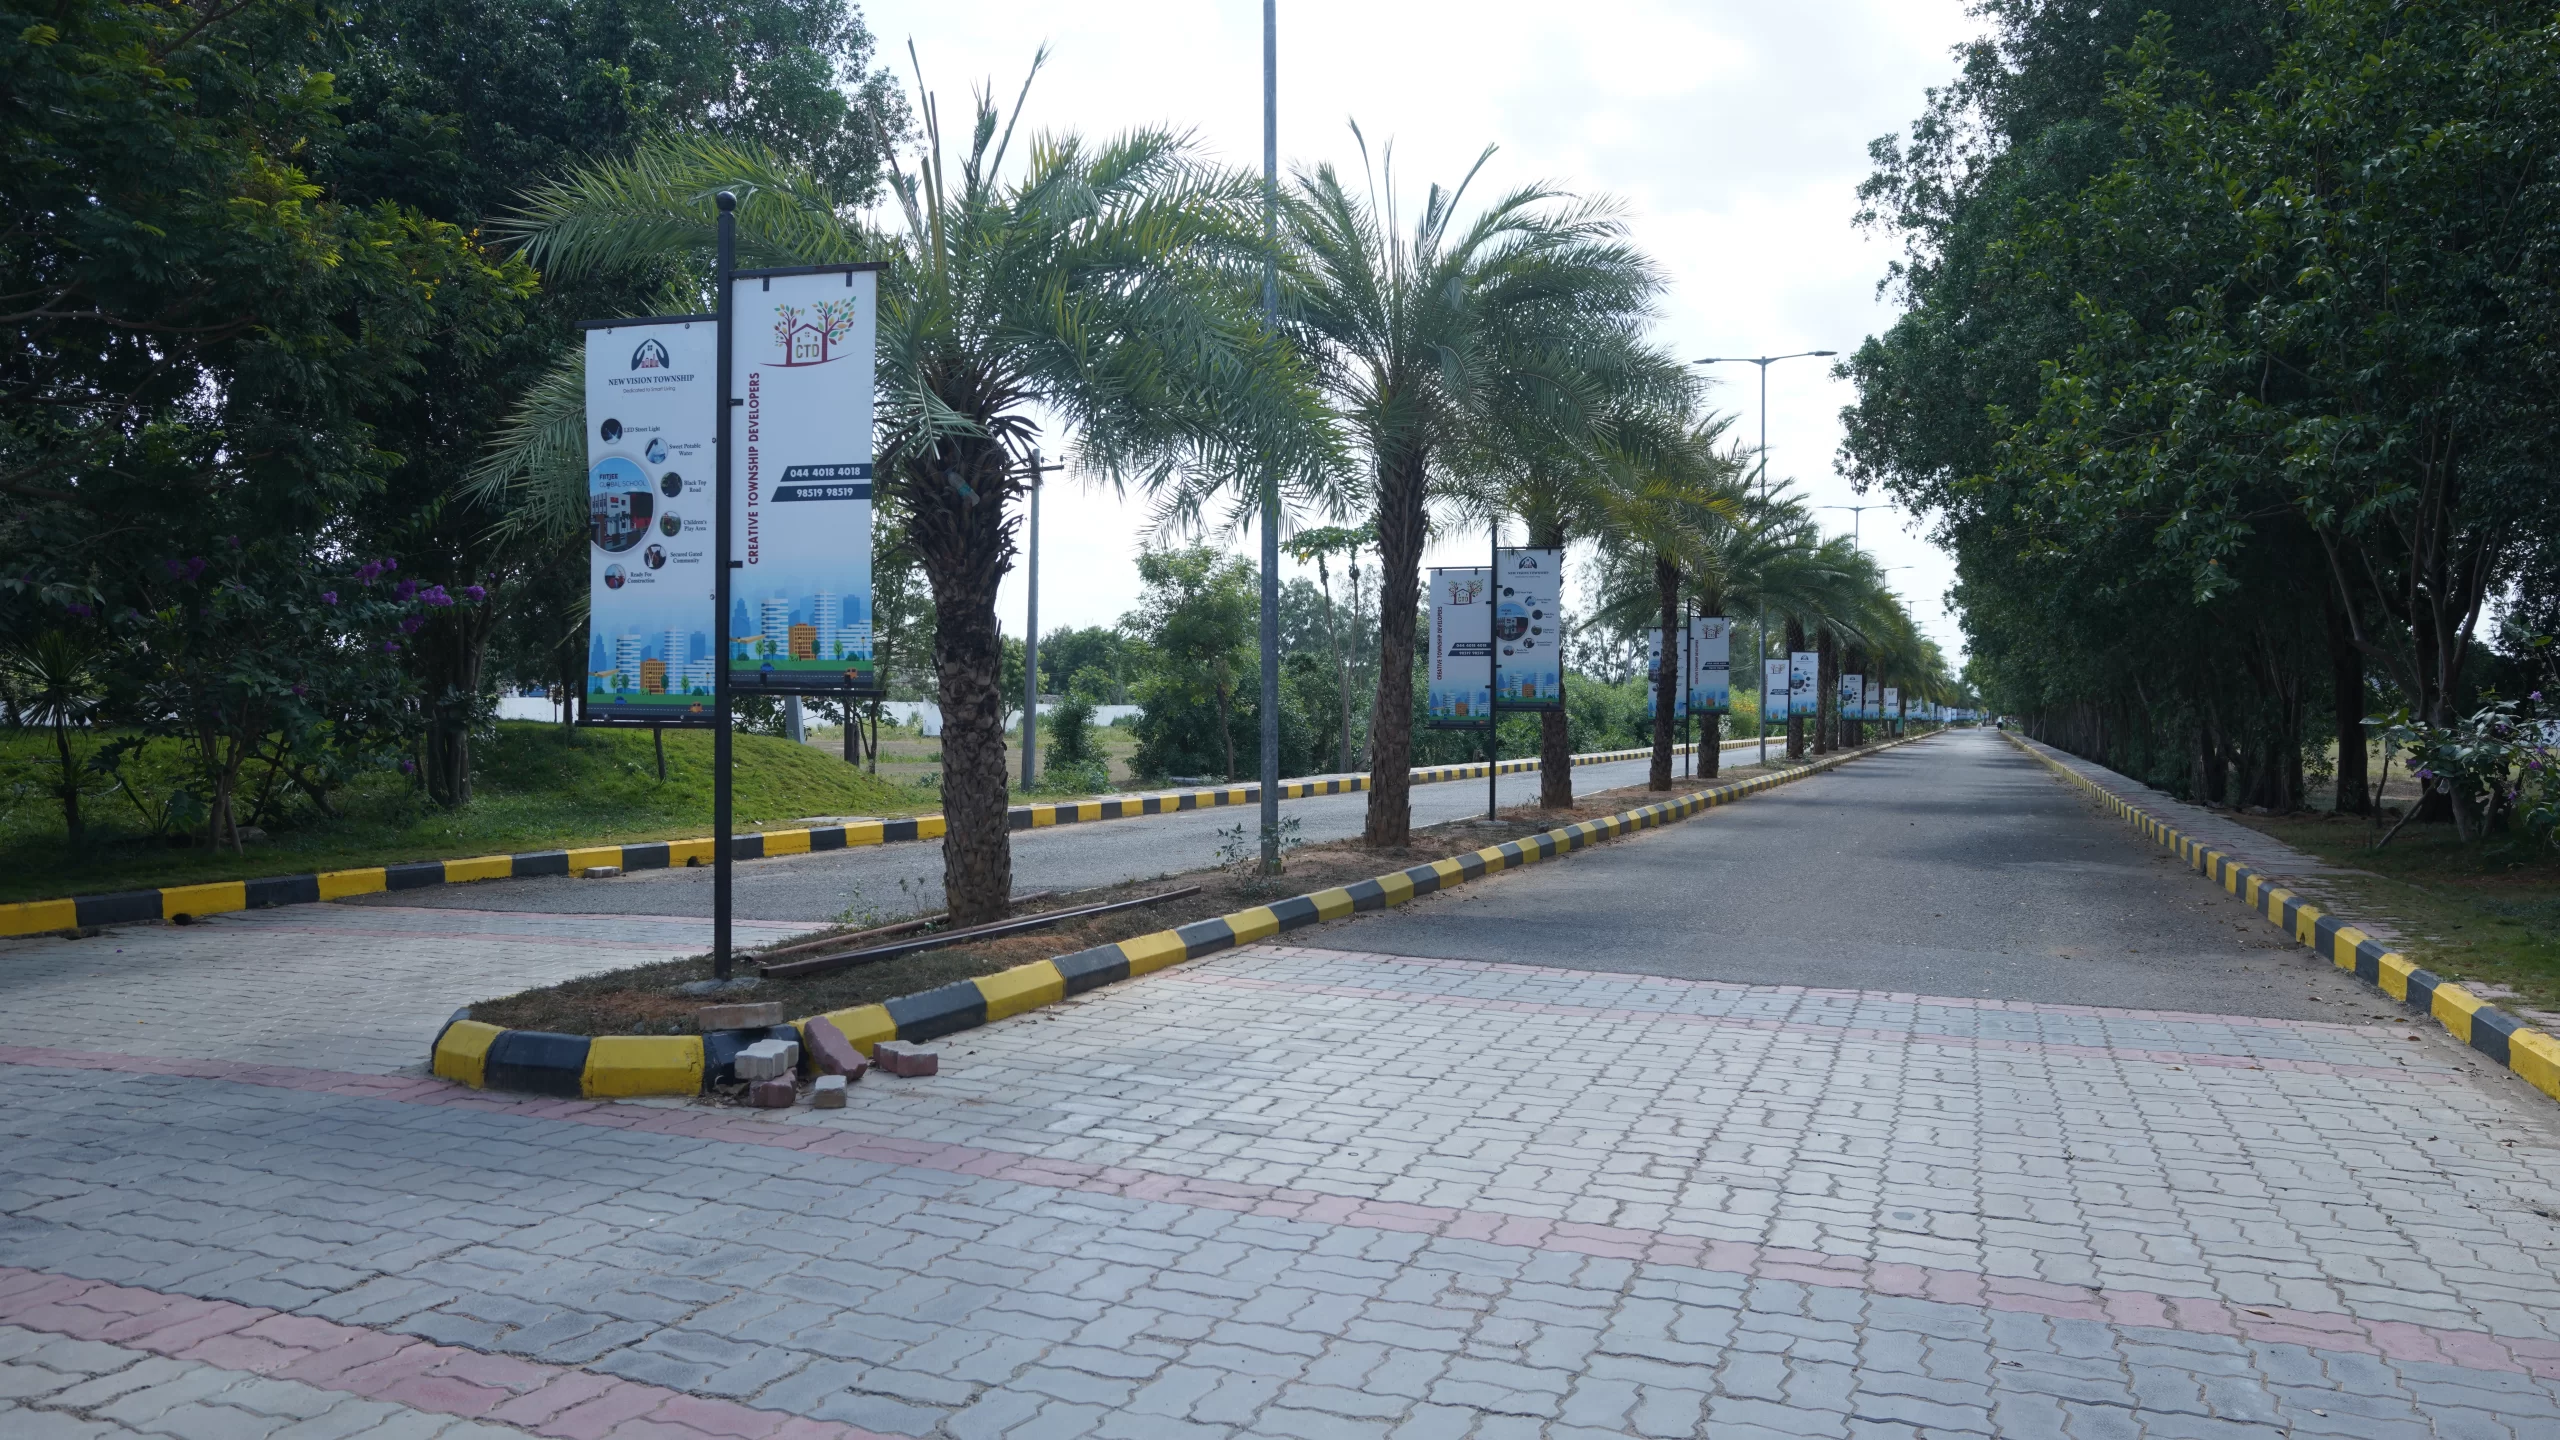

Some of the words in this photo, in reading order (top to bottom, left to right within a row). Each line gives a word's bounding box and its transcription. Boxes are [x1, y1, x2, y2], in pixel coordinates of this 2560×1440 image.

[795, 343, 820, 359] CTD
[626, 376, 652, 385] VISION
[653, 374, 694, 384] TOWNSHIP
[748, 372, 760, 442] DEVELOPERS
[748, 445, 760, 508] TOWNSHIP
[790, 468, 809, 478] 044
[812, 467, 835, 477] 4018
[838, 466, 861, 476] 4018
[622, 480, 646, 488] SCHOOL
[796, 488, 823, 498] 98519
[826, 487, 853, 497] 98519
[748, 511, 760, 565] CREATIVE
